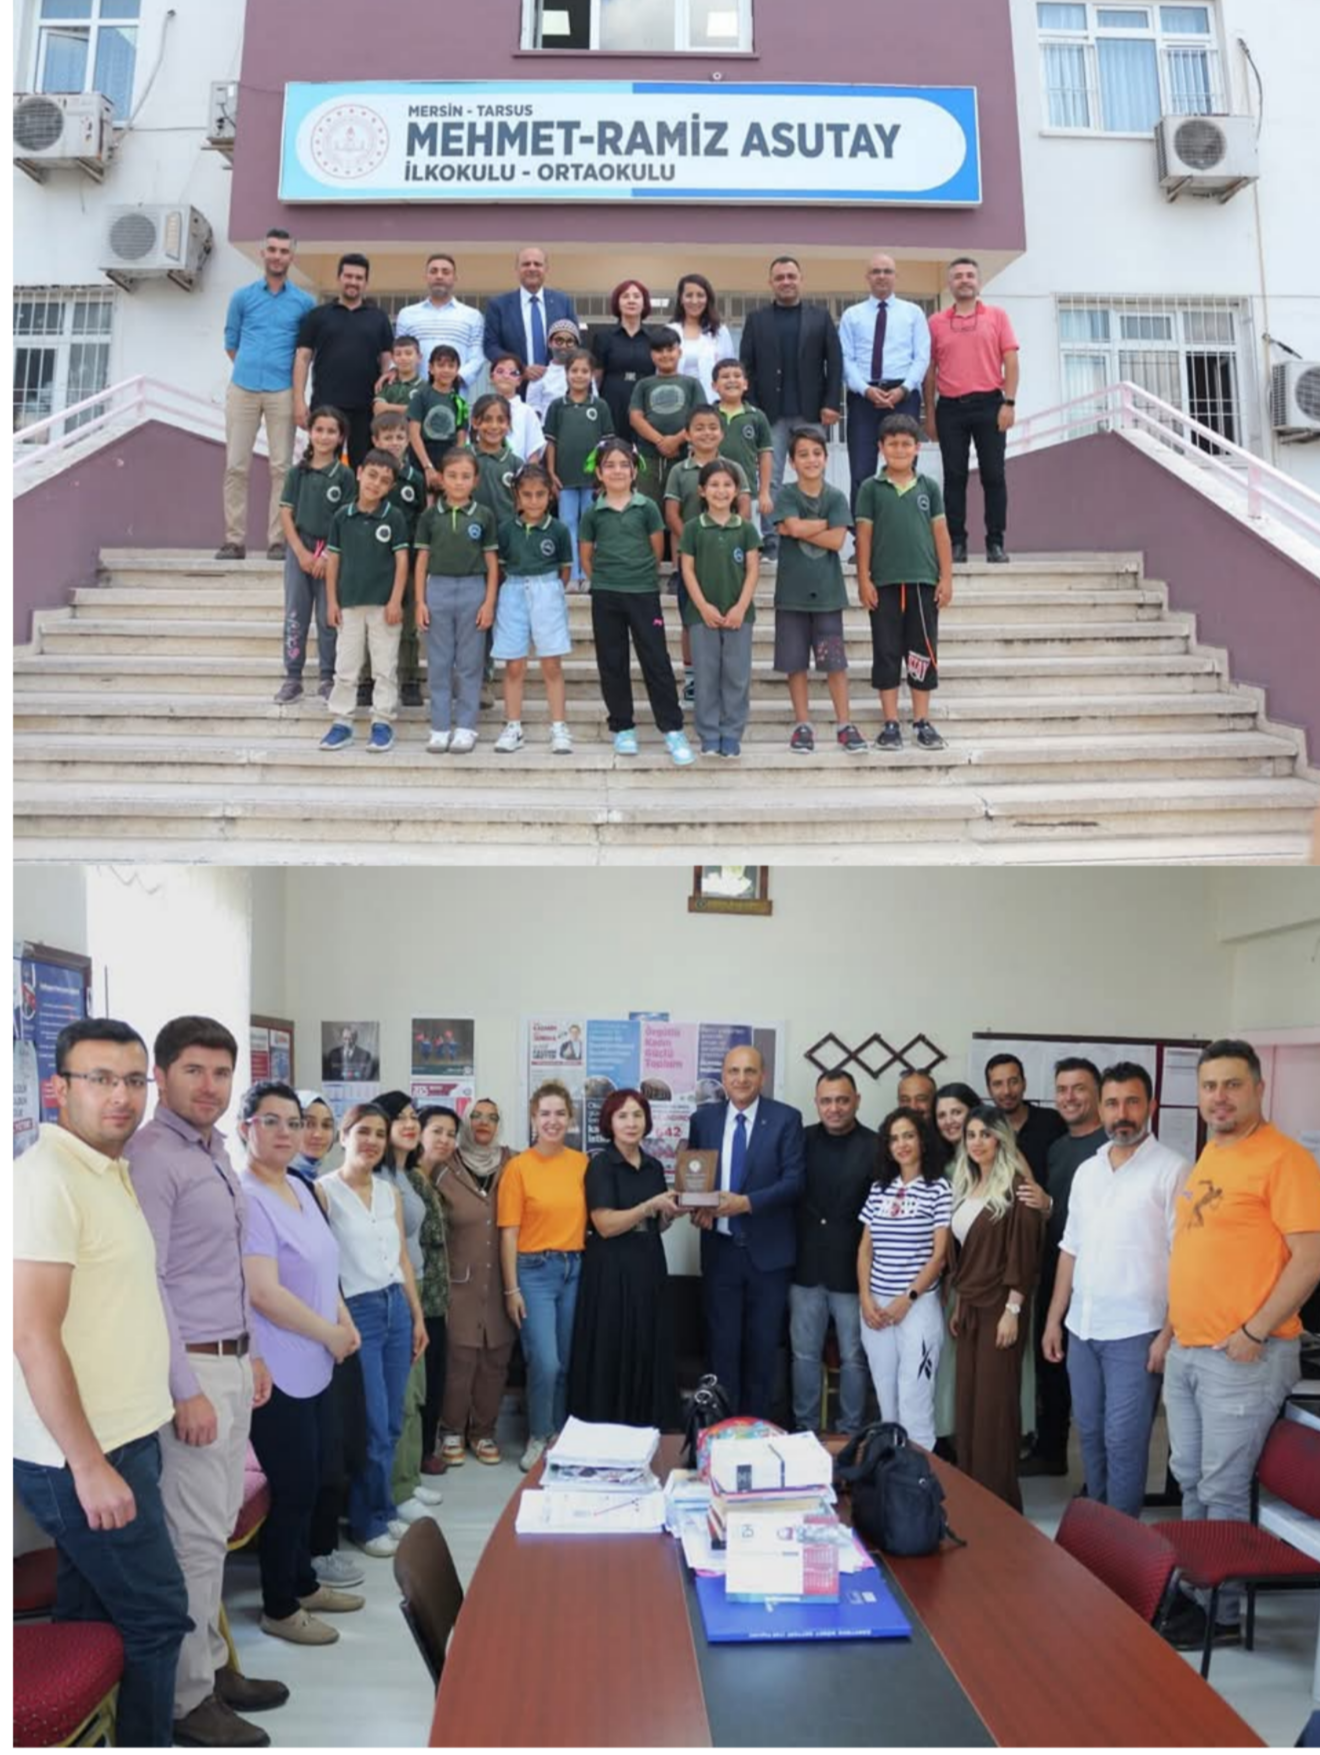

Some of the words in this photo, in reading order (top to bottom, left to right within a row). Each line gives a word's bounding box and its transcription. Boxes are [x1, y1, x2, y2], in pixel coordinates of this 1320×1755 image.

[408, 103, 463, 117] MERSİN
[477, 104, 533, 117] TARSUS
[406, 113, 729, 157] MEHMET-RAMİZ
[740, 121, 901, 159] ASUTAY
[404, 160, 516, 181] İLKOKULU
[537, 163, 675, 181] ORTAOKULU
